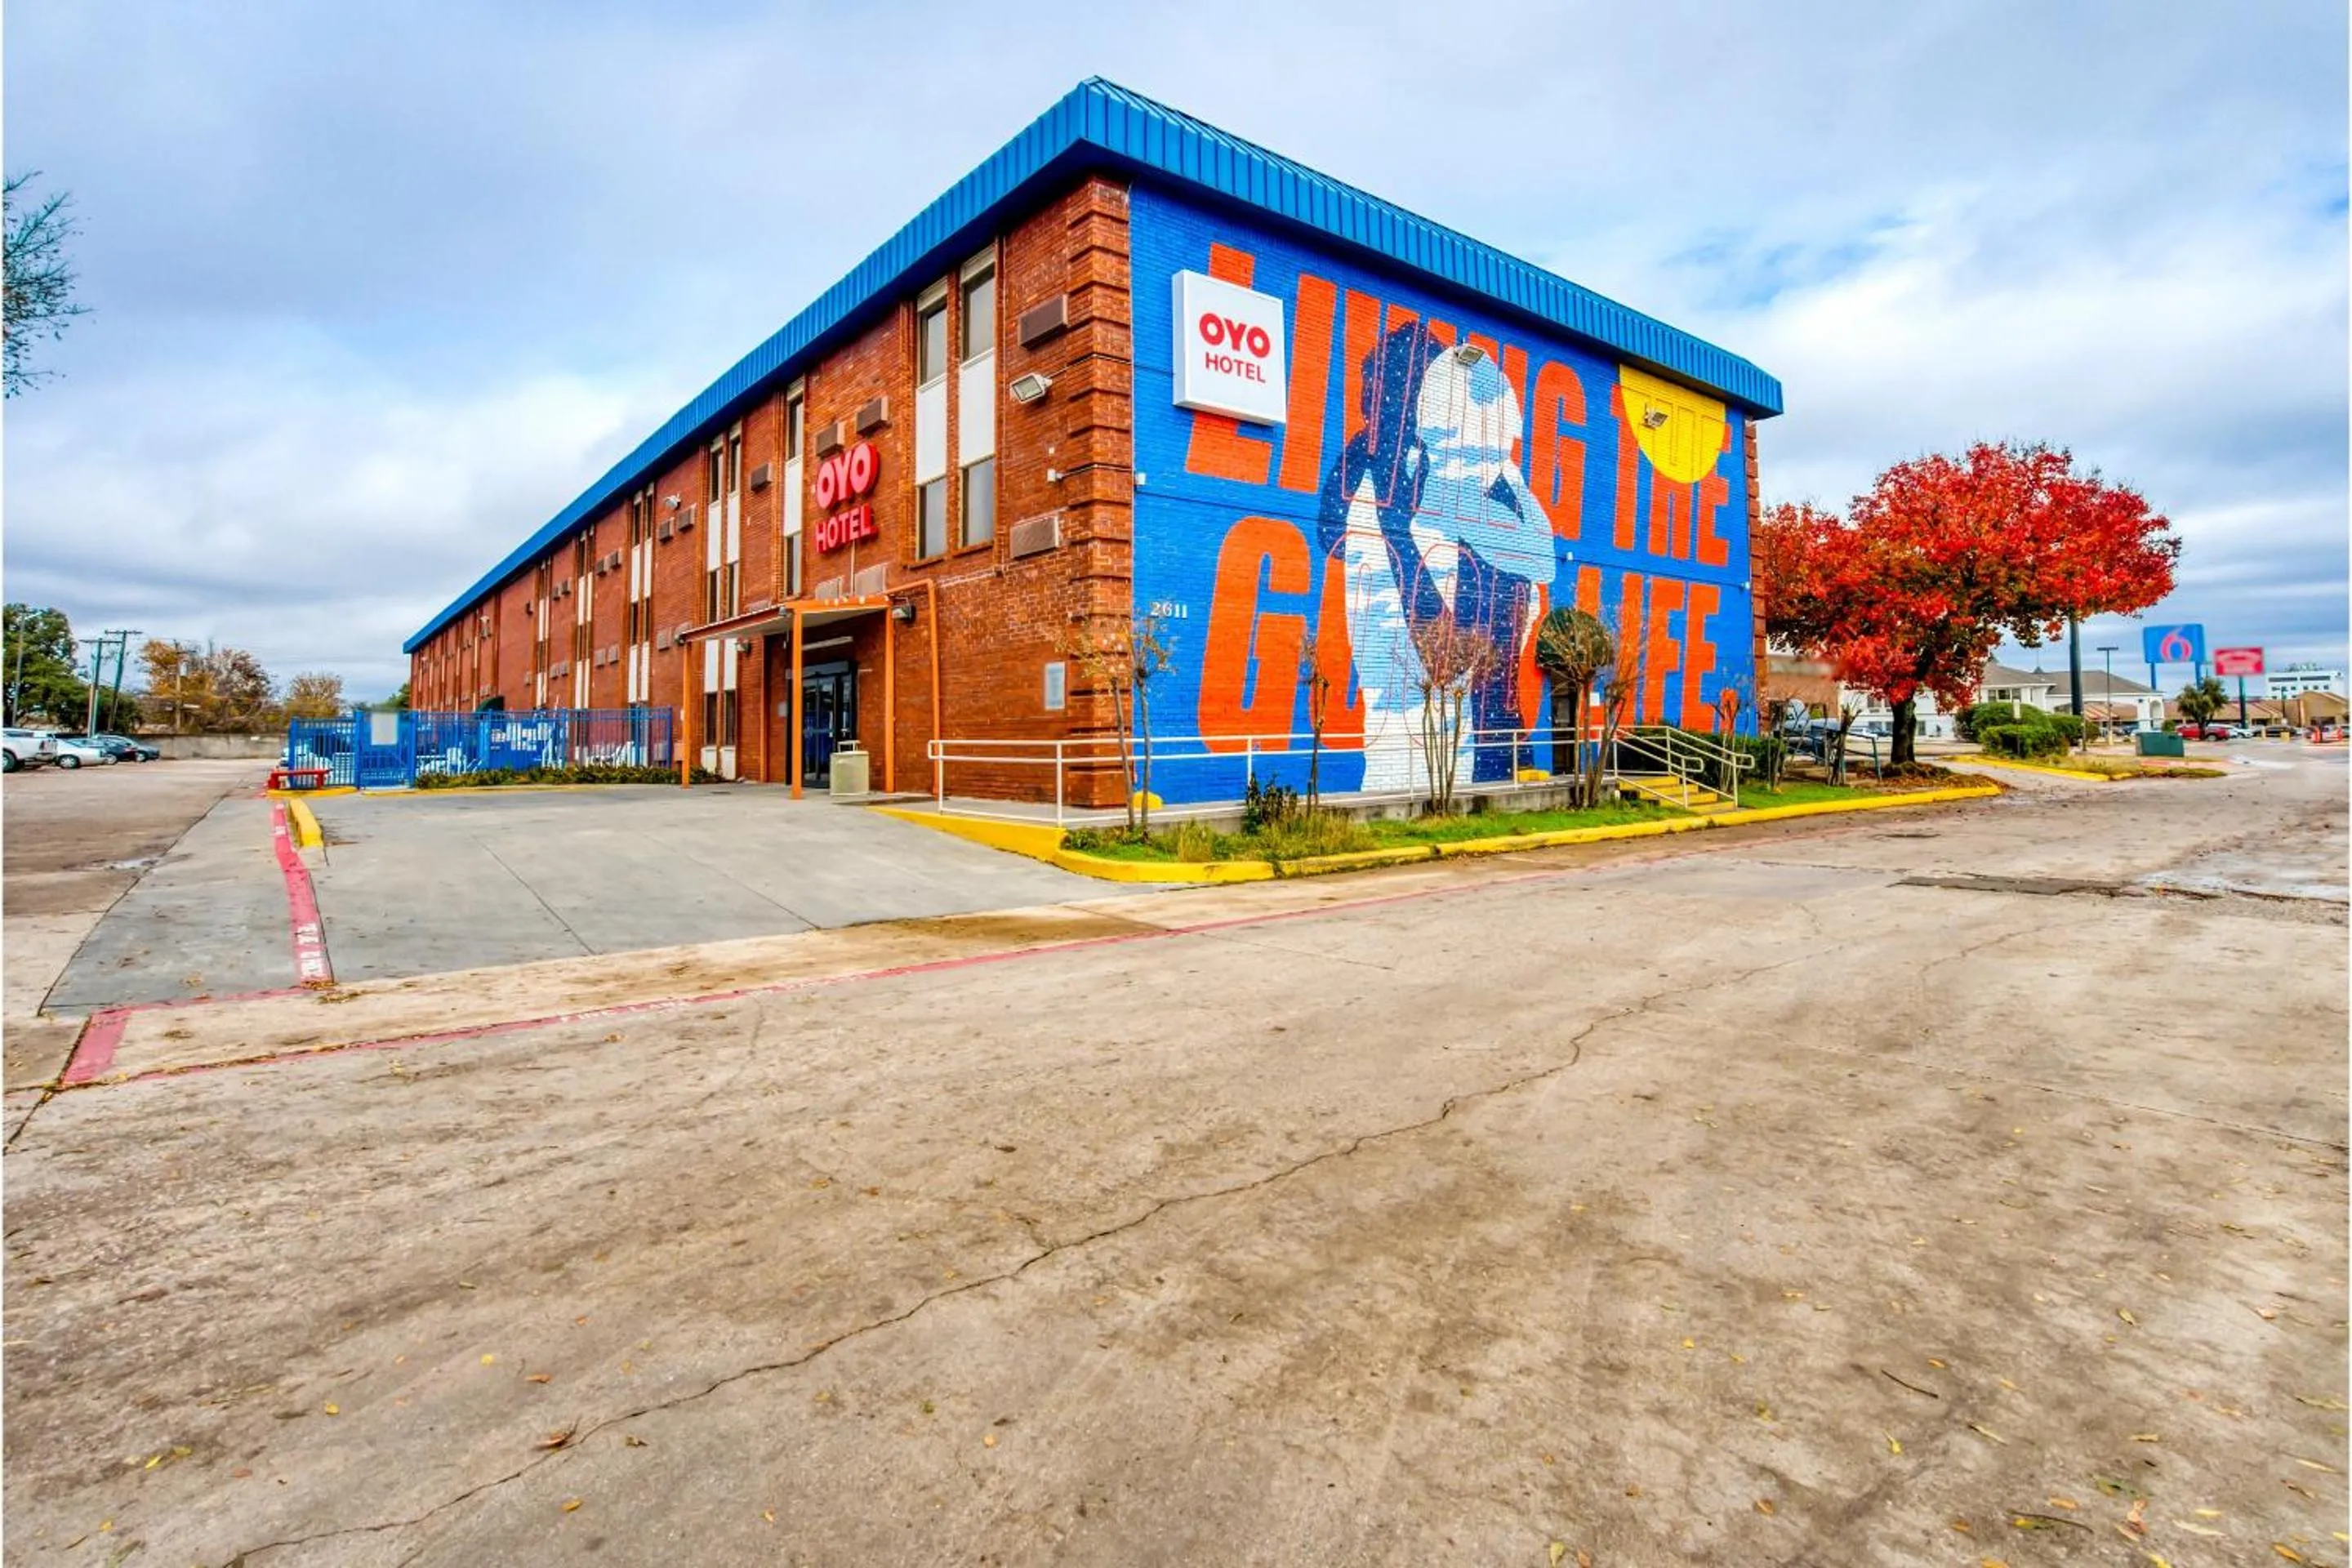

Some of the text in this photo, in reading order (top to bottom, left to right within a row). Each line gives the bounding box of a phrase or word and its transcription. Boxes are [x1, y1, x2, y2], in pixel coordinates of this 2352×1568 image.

[1199, 313, 1271, 359] OYO
[1205, 352, 1266, 384] HOTEL
[817, 442, 878, 510] OYO
[1610, 382, 1733, 567] THE
[816, 505, 878, 553] HOTEL
[1150, 601, 1187, 618] 2611
[2160, 626, 2193, 663] 6
